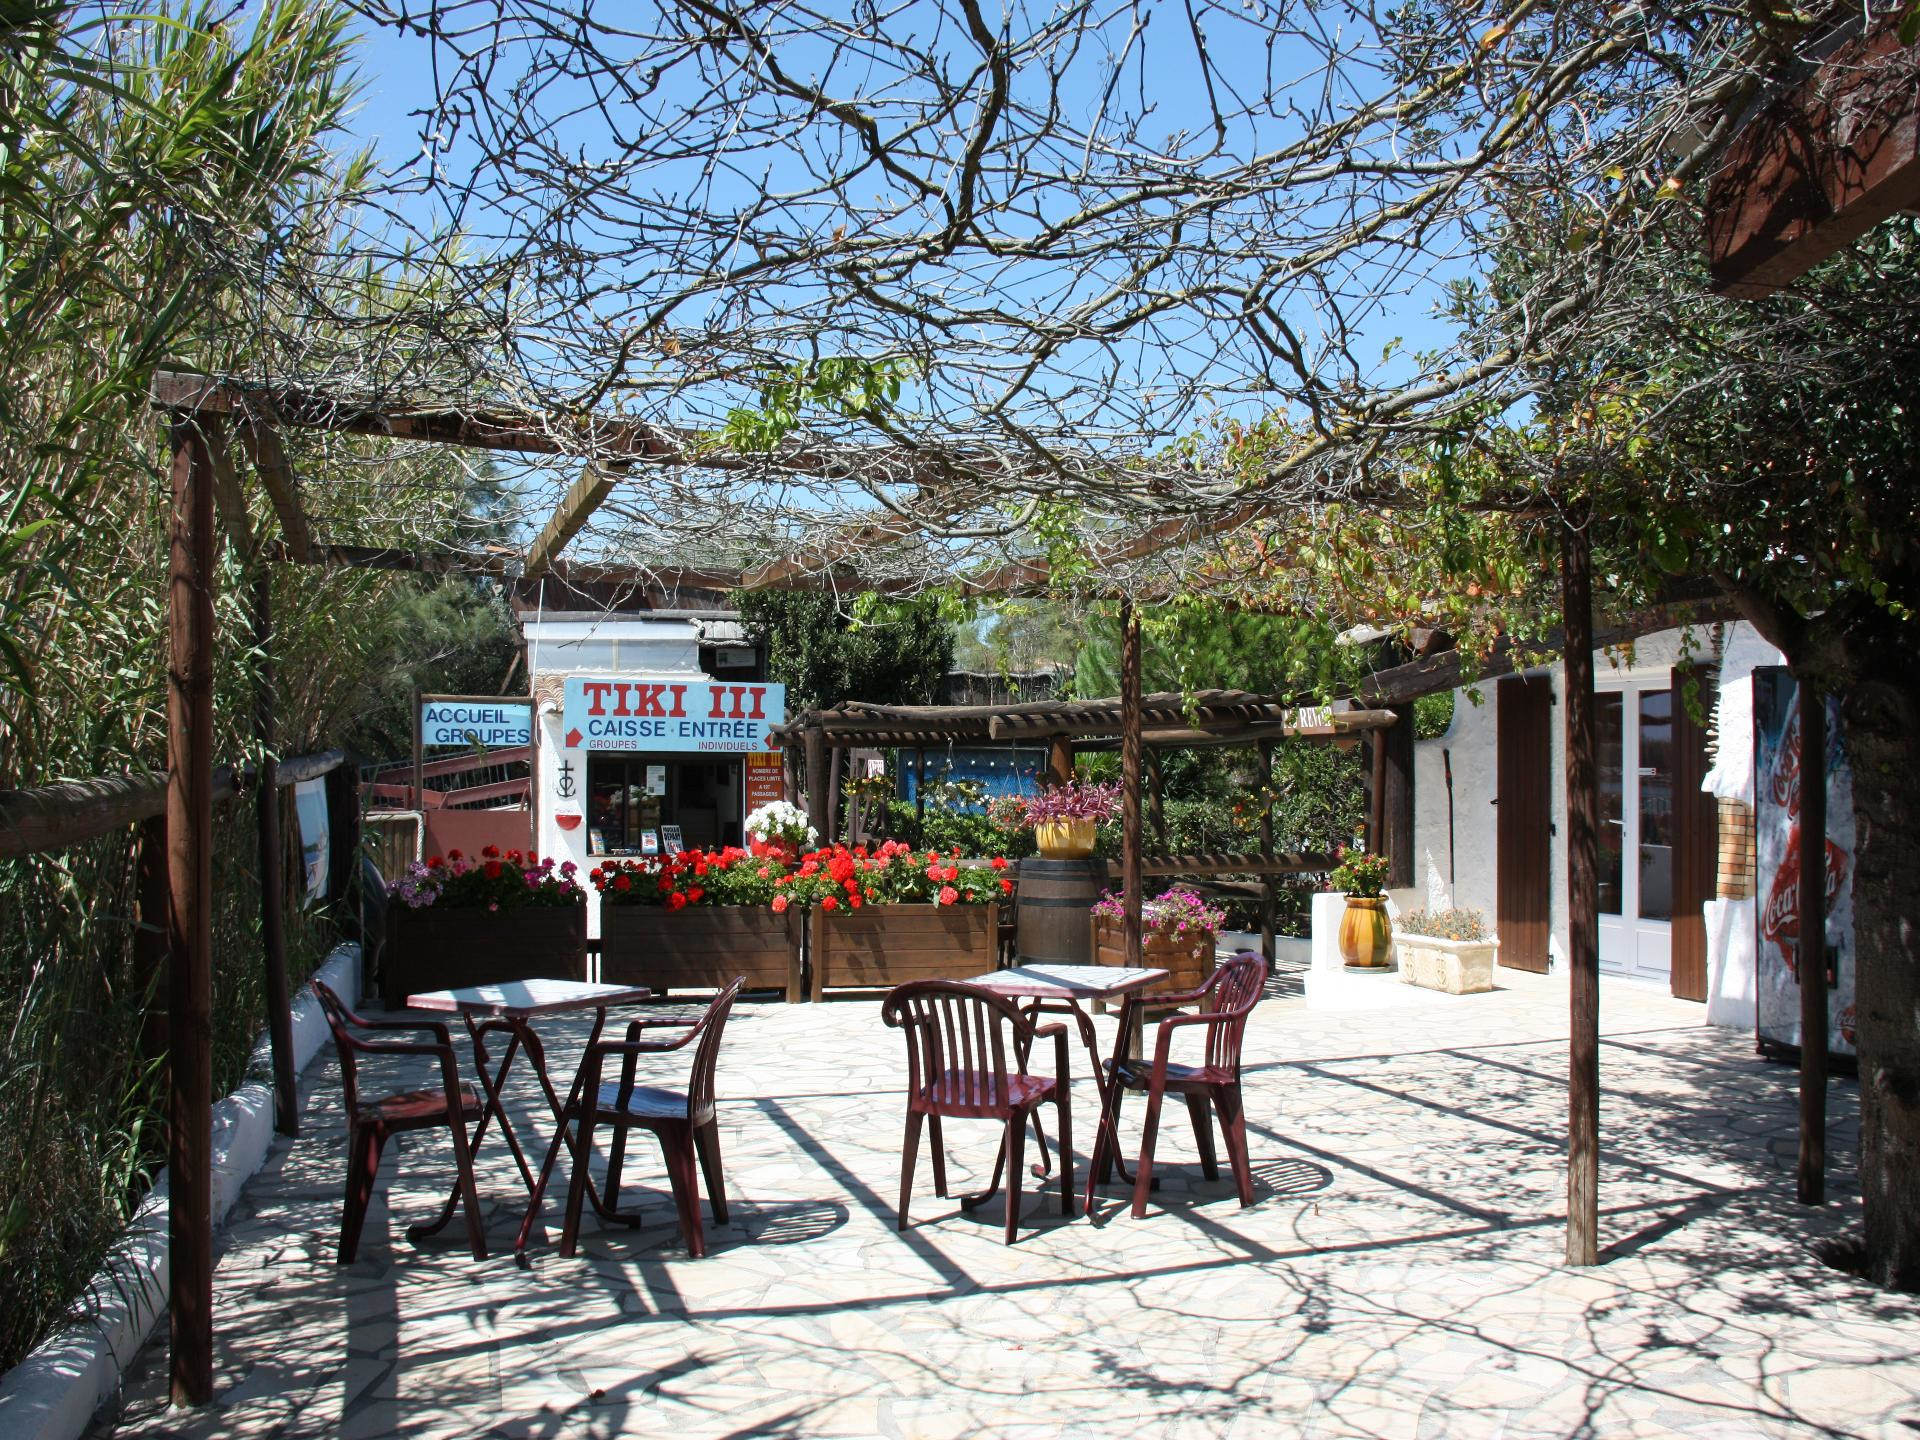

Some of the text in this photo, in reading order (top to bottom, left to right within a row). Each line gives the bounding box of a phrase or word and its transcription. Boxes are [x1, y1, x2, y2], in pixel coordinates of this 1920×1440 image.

[583, 683, 767, 719] TIKI III
[425, 708, 510, 724] ACCUEIL
[435, 728, 530, 743] GROUPES
[588, 719, 758, 739] CAISSE ENTRÉE
[589, 740, 758, 751] GROUPES INDIVIDUELS
[747, 752, 766, 767] TIKI
